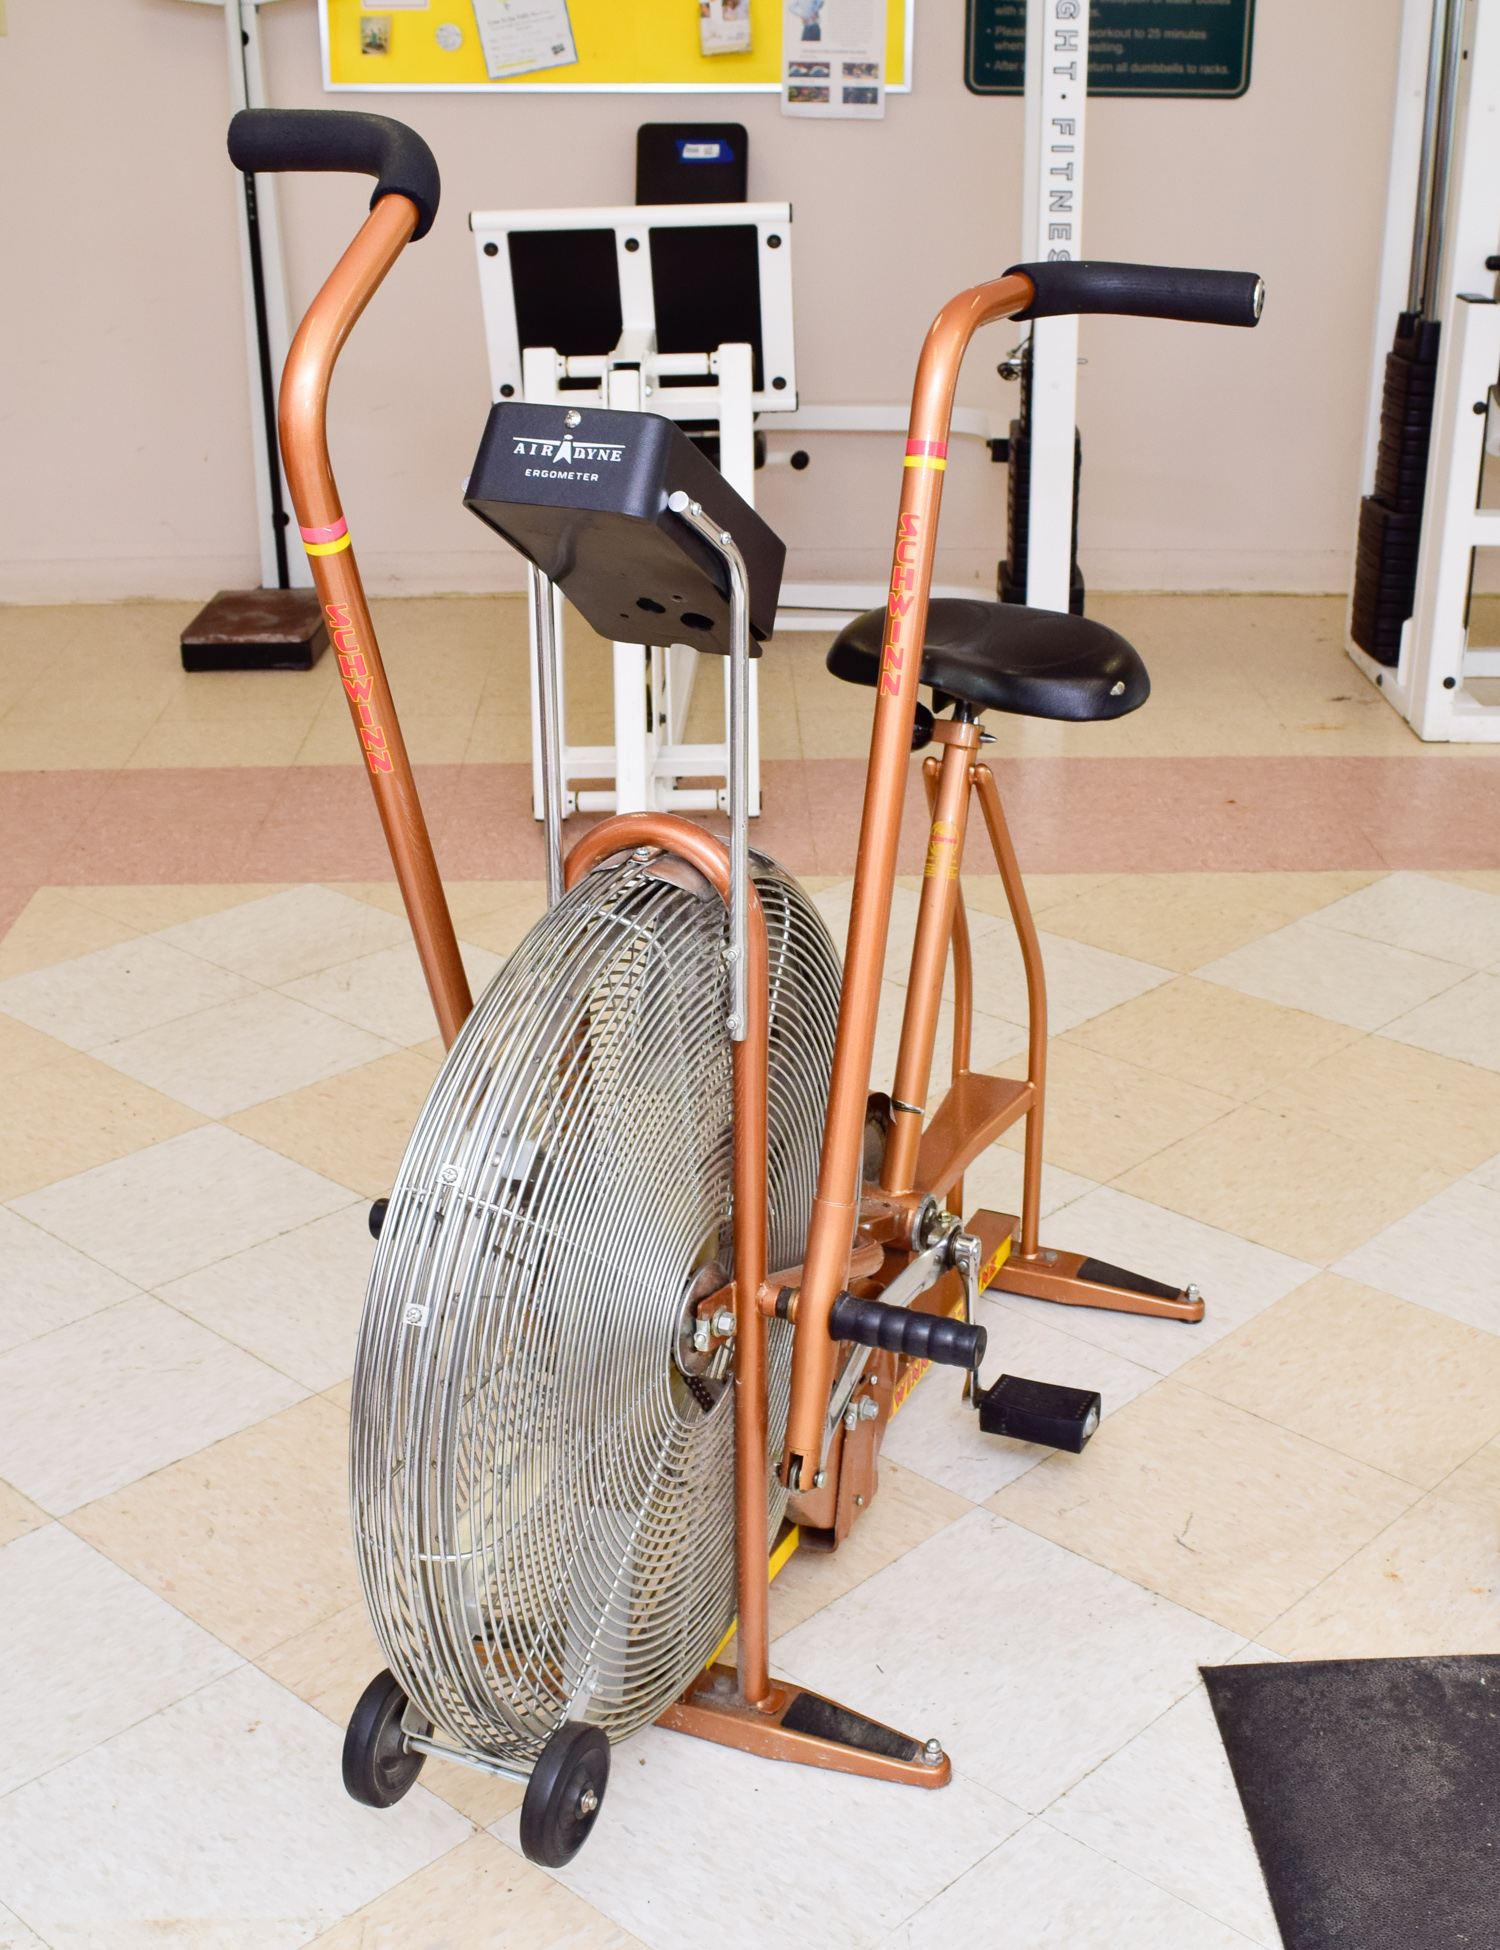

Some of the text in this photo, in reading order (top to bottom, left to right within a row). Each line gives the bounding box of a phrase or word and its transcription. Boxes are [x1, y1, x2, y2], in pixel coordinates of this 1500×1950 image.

[1133, 28, 1146, 39] to
[1164, 28, 1207, 40] minutes
[1130, 62, 1184, 74] dumbbells
[1186, 63, 1198, 74] to
[524, 468, 600, 482] ERGOMETER
[880, 512, 921, 697] SCHWINN
[325, 602, 395, 774] SCHWINN
